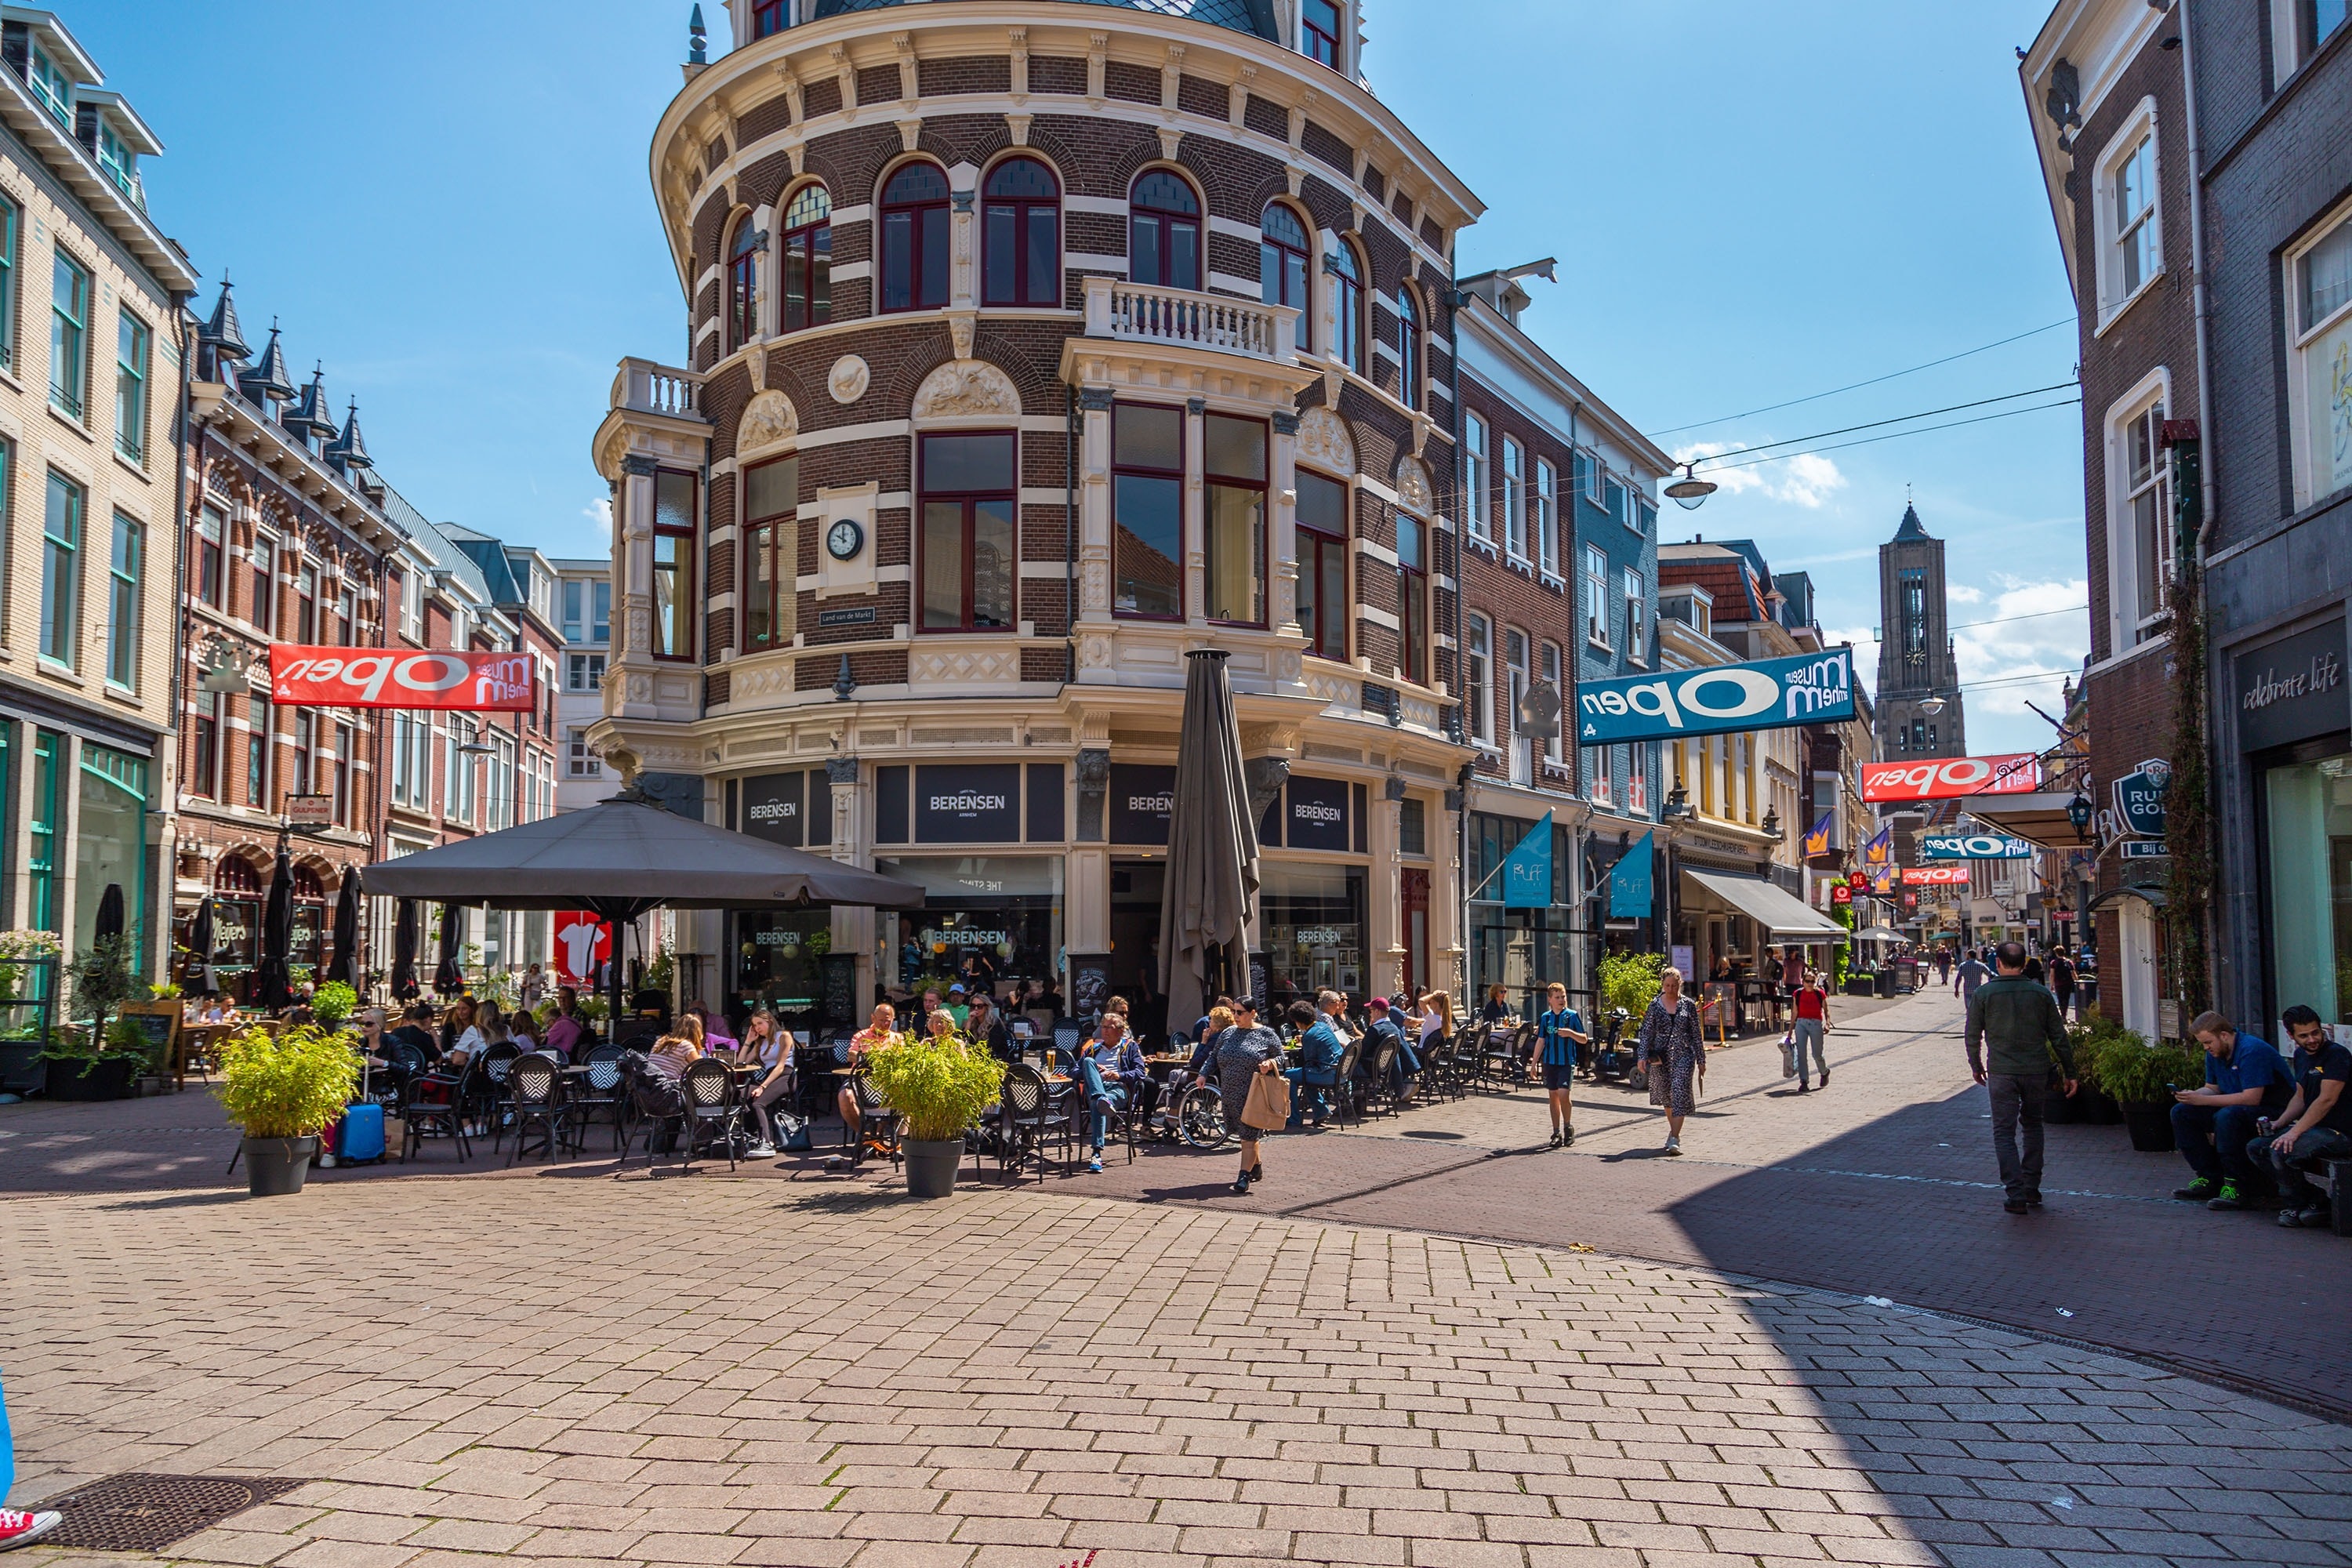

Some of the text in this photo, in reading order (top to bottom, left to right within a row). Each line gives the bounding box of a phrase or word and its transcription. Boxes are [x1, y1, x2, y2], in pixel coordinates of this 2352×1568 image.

[2244, 652, 2339, 710] celebrate life
[750, 802, 796, 819] BERENSEN
[930, 795, 1005, 811] BERENSEN
[1128, 797, 1174, 811] BEREN
[1295, 804, 1341, 821] BERENSEN
[2142, 844, 2156, 855] Bij
[291, 924, 311, 948] eijers
[756, 931, 800, 945] BERENSEN
[934, 931, 1006, 945] BERENSEN
[1298, 931, 1341, 943] BERENSEN
